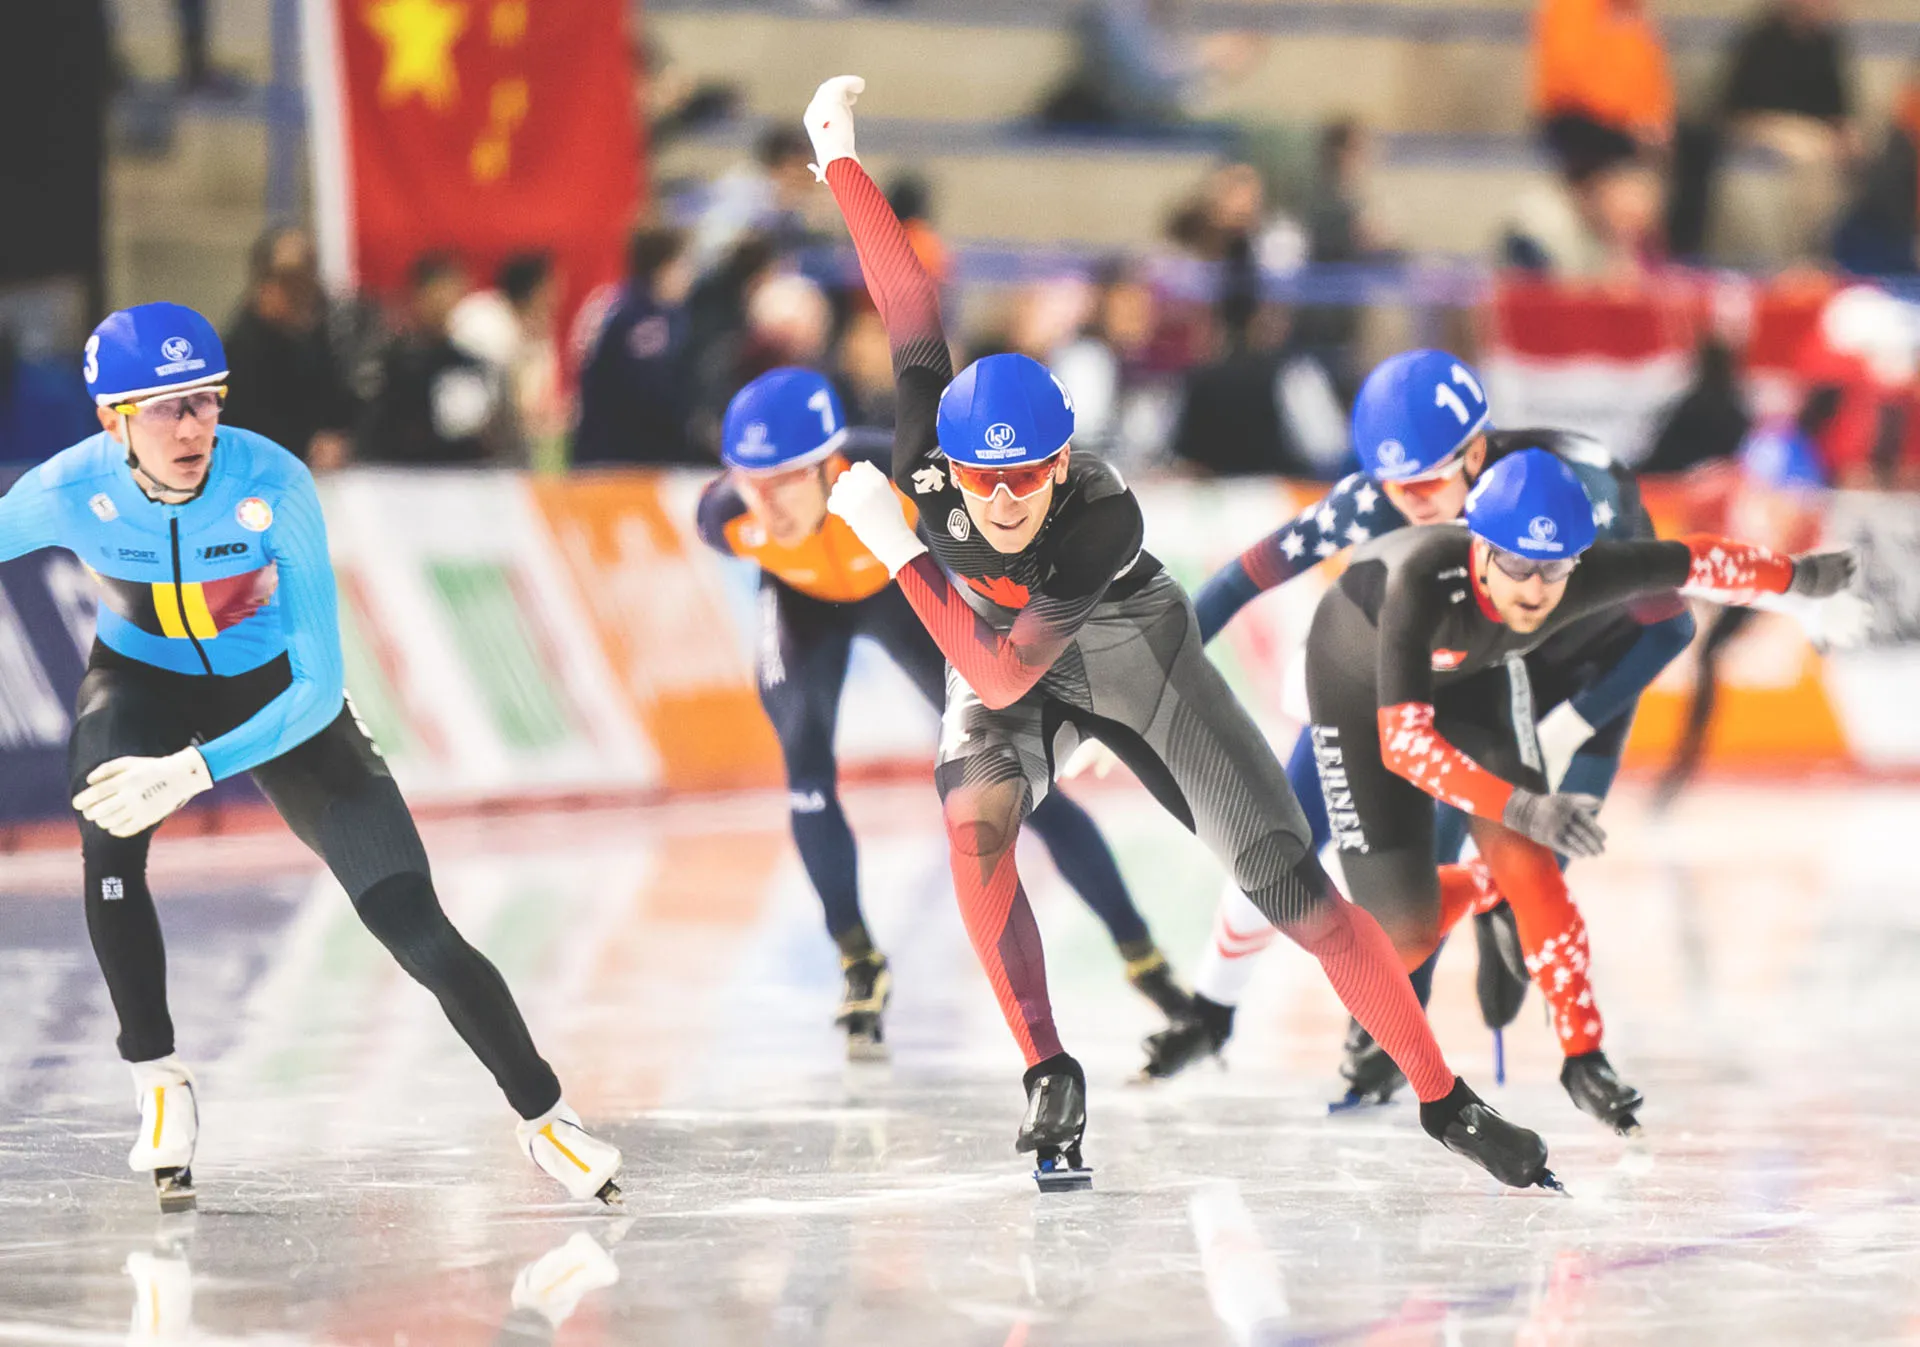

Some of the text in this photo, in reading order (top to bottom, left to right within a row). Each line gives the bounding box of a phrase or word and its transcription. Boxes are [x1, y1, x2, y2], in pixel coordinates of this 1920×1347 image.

[83, 335, 99, 384] 3
[808, 389, 836, 433] 1
[1435, 364, 1483, 424] 11
[990, 428, 1010, 446] ISU
[118, 548, 156, 558] SPORT
[204, 543, 248, 559] IKO
[1311, 724, 1366, 853] LEHNER
